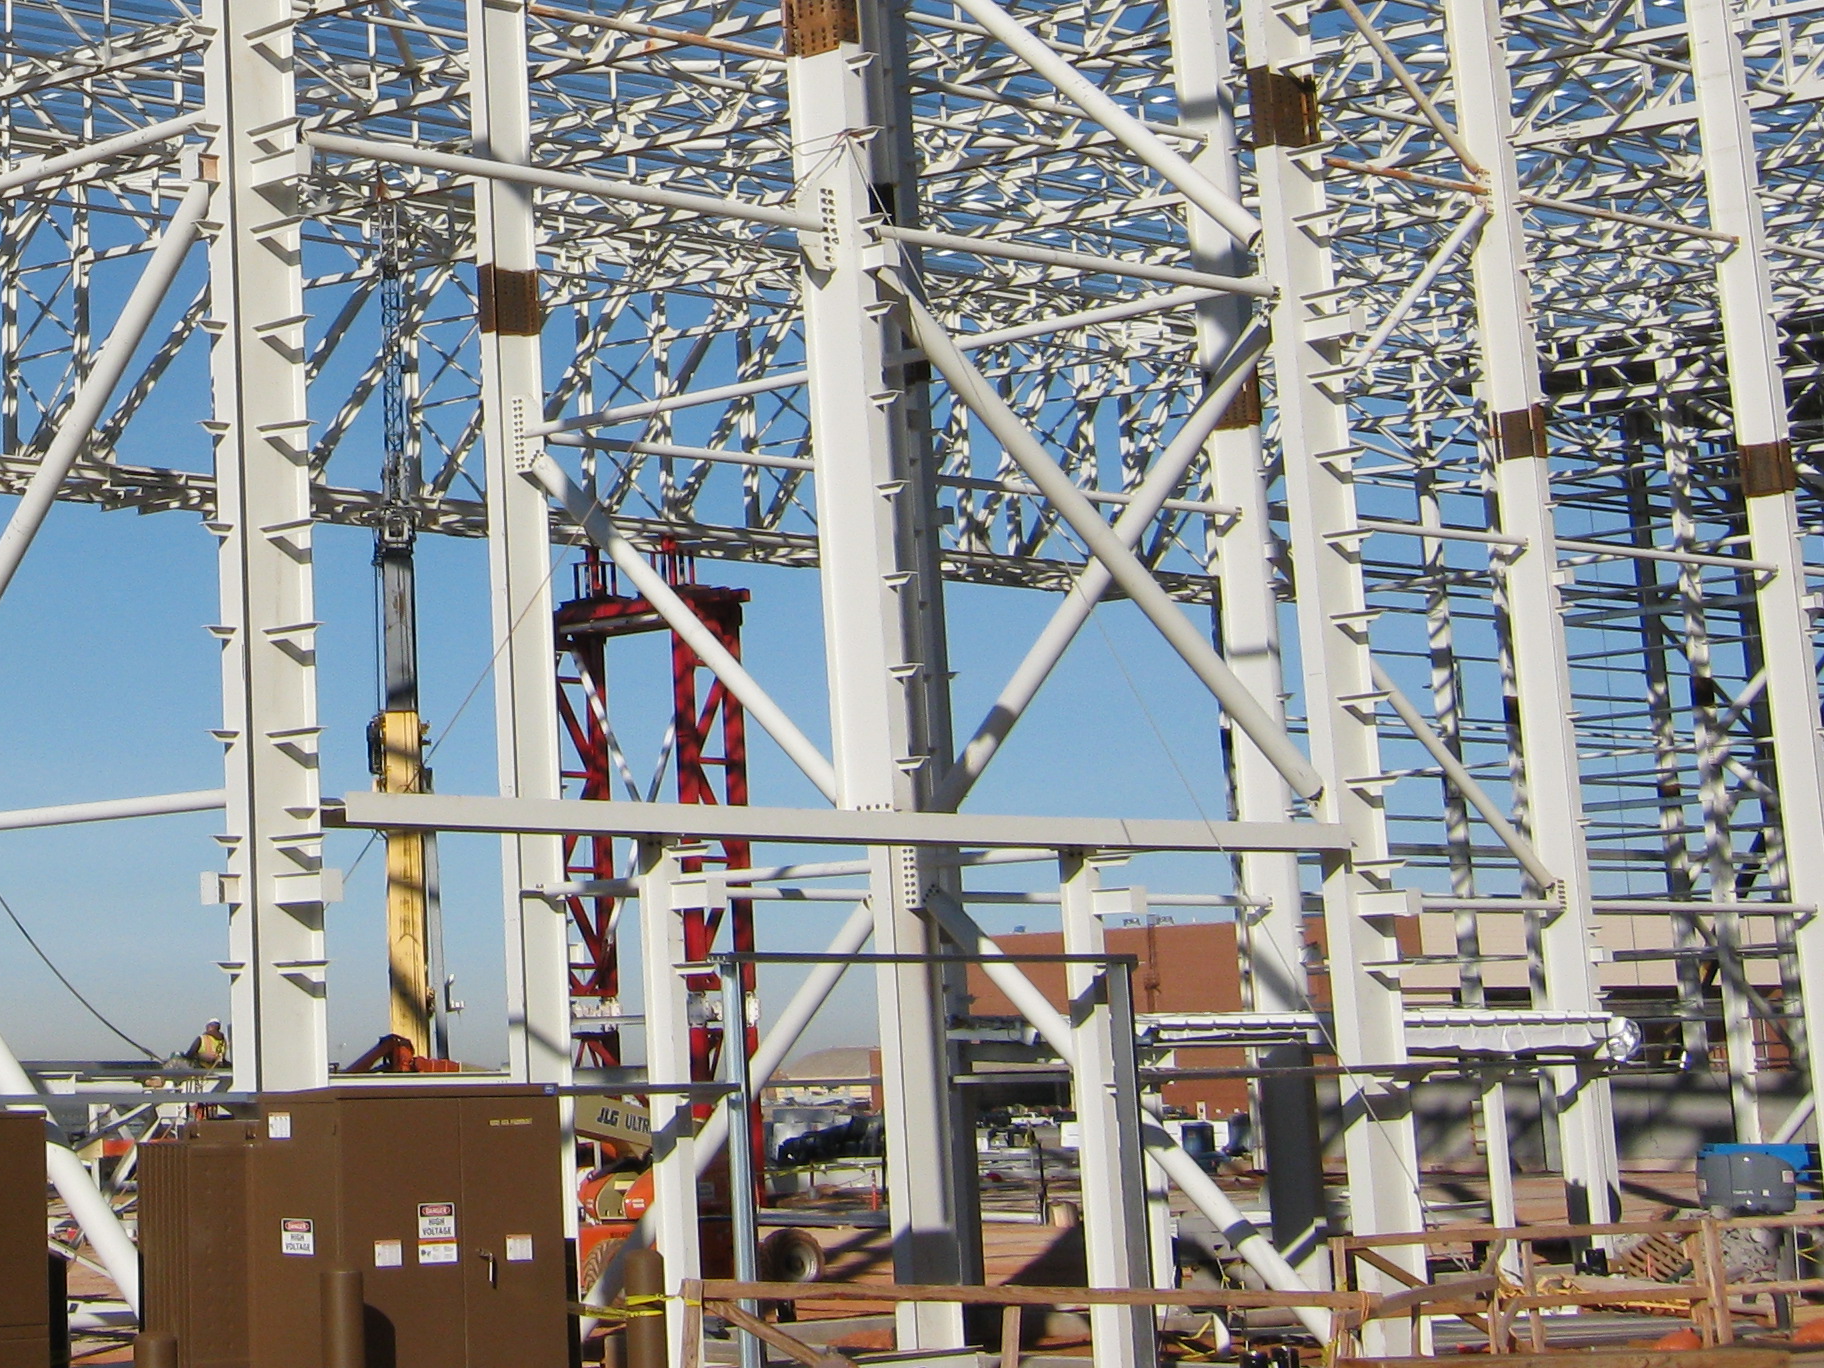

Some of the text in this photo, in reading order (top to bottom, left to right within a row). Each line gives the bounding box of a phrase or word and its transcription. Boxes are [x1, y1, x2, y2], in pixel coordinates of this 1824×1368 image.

[597, 1107, 652, 1133] JLG ULTR
[422, 1227, 452, 1235] VOLTAGE
[285, 1243, 311, 1252] VOLTAGE
